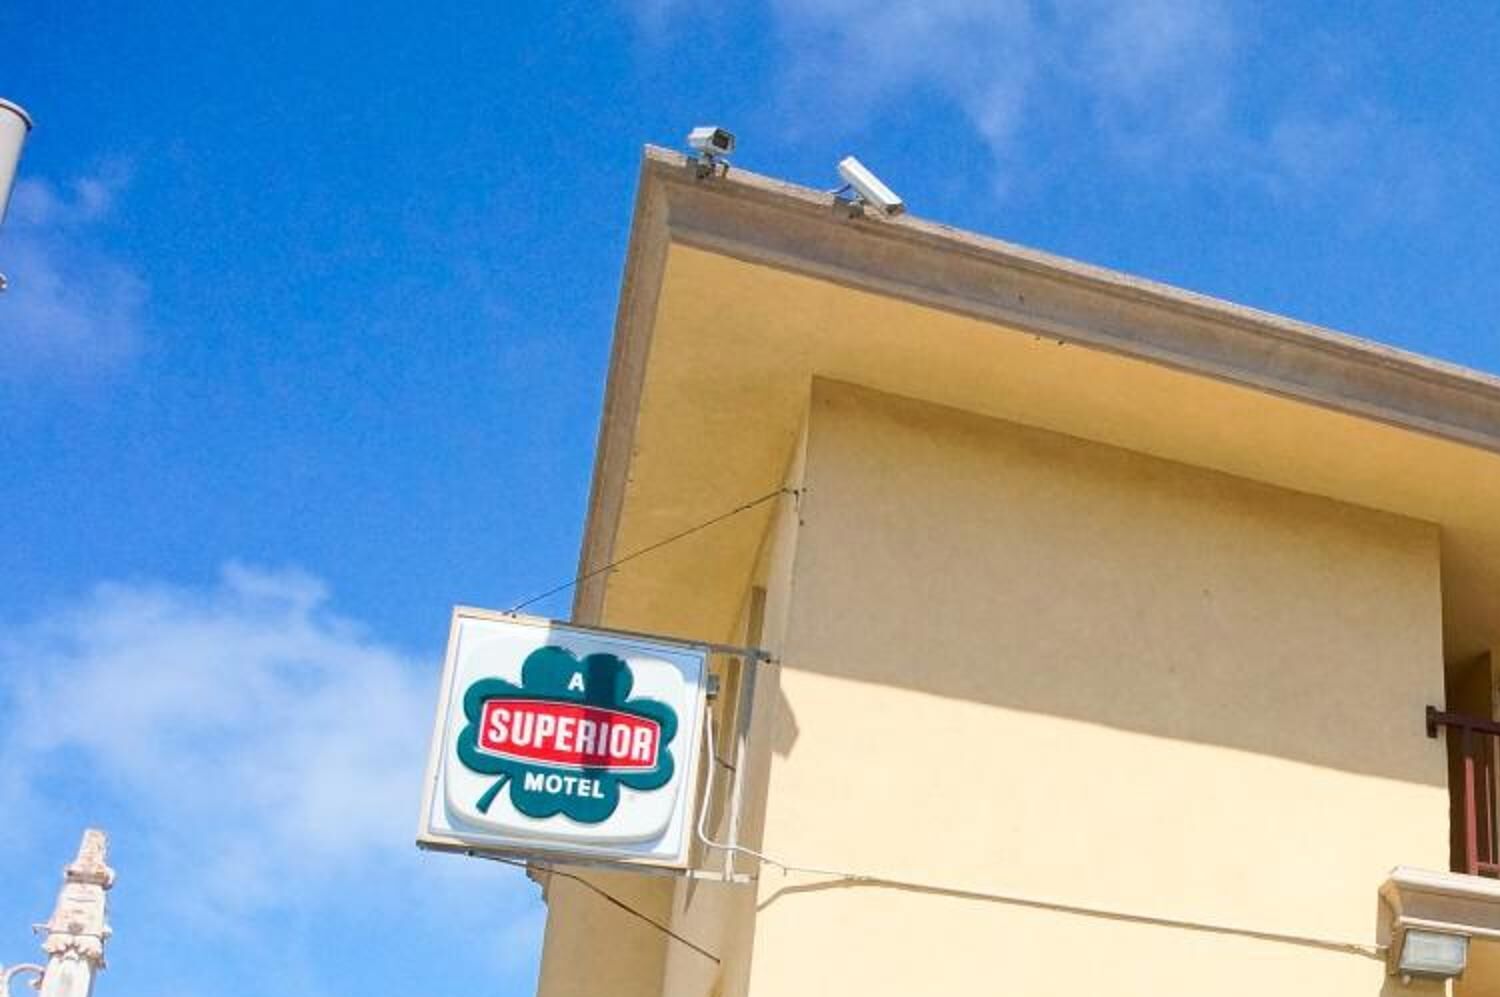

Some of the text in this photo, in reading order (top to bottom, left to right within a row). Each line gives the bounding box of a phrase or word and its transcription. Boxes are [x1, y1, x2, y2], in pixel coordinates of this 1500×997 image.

[567, 672, 585, 692] A
[487, 708, 655, 761] SUPERIOR
[523, 772, 605, 799] MOTEL
